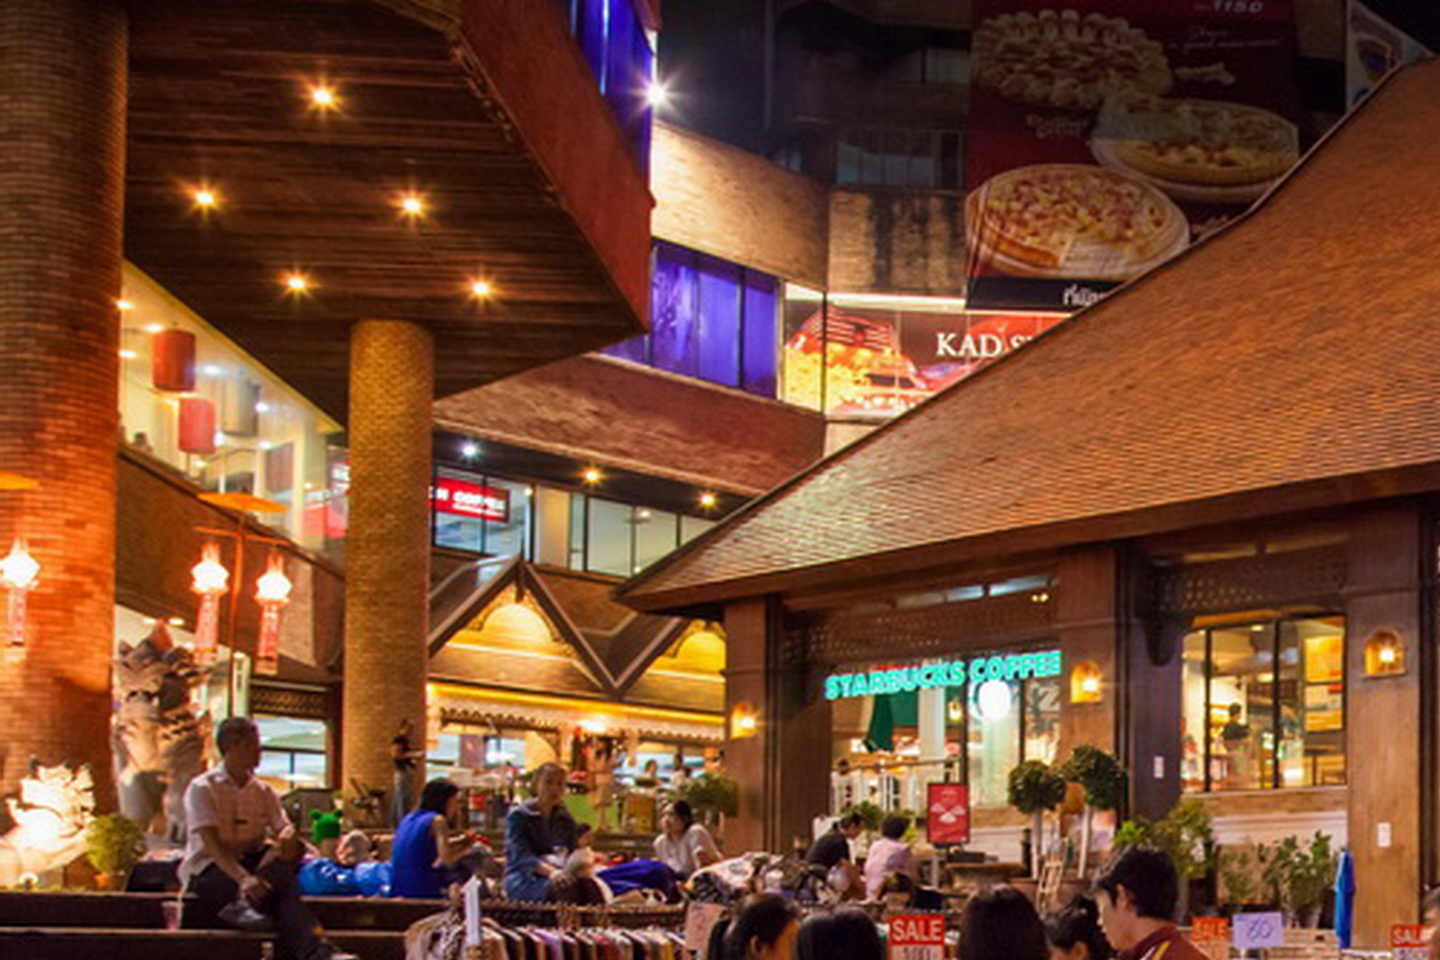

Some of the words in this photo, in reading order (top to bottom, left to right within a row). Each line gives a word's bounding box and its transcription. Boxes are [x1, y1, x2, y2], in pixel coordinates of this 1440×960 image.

[936, 332, 1002, 357] KAD
[824, 660, 965, 700] STARBUCKS
[970, 650, 1061, 682] COFFEE
[892, 920, 942, 941] SALE
[1193, 919, 1227, 940] SALE
[1393, 927, 1424, 944] SAL
